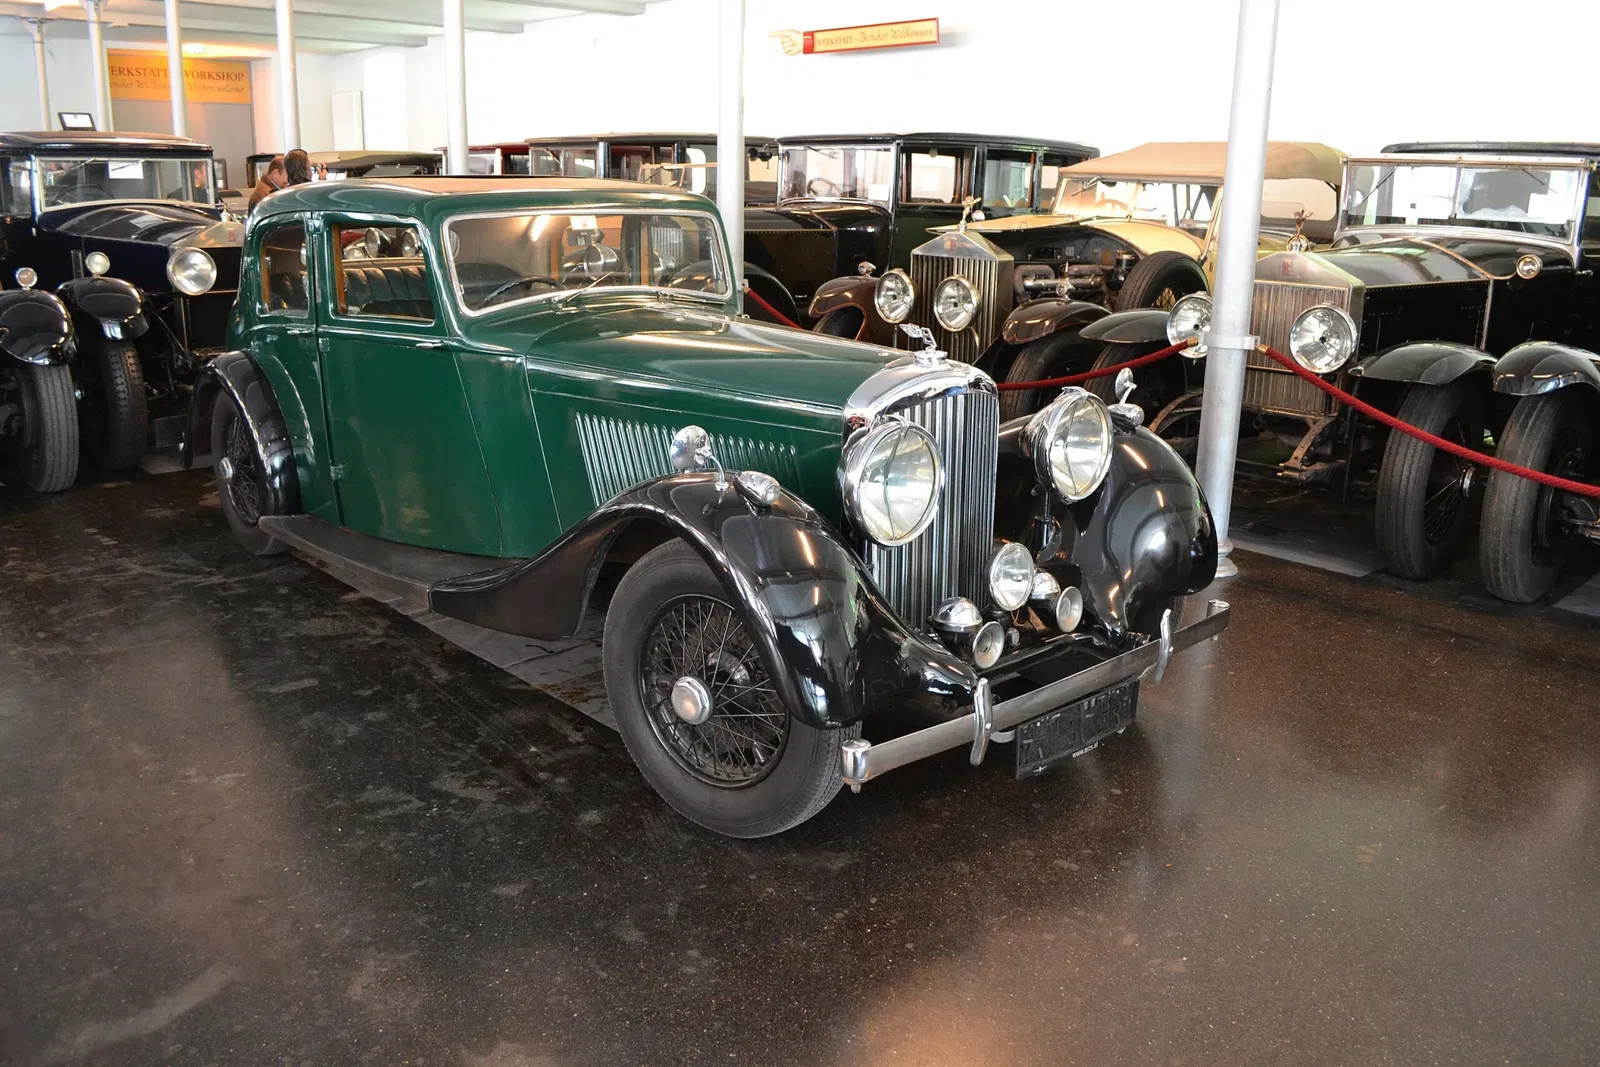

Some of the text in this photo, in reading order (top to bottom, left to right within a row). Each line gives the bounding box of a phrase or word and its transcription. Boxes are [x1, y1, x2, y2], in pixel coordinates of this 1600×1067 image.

[816, 36, 854, 46] WERKSTATT
[860, 28, 889, 43] Besucher
[890, 25, 933, 39] Willkommen
[109, 65, 170, 79] ERKSTATT
